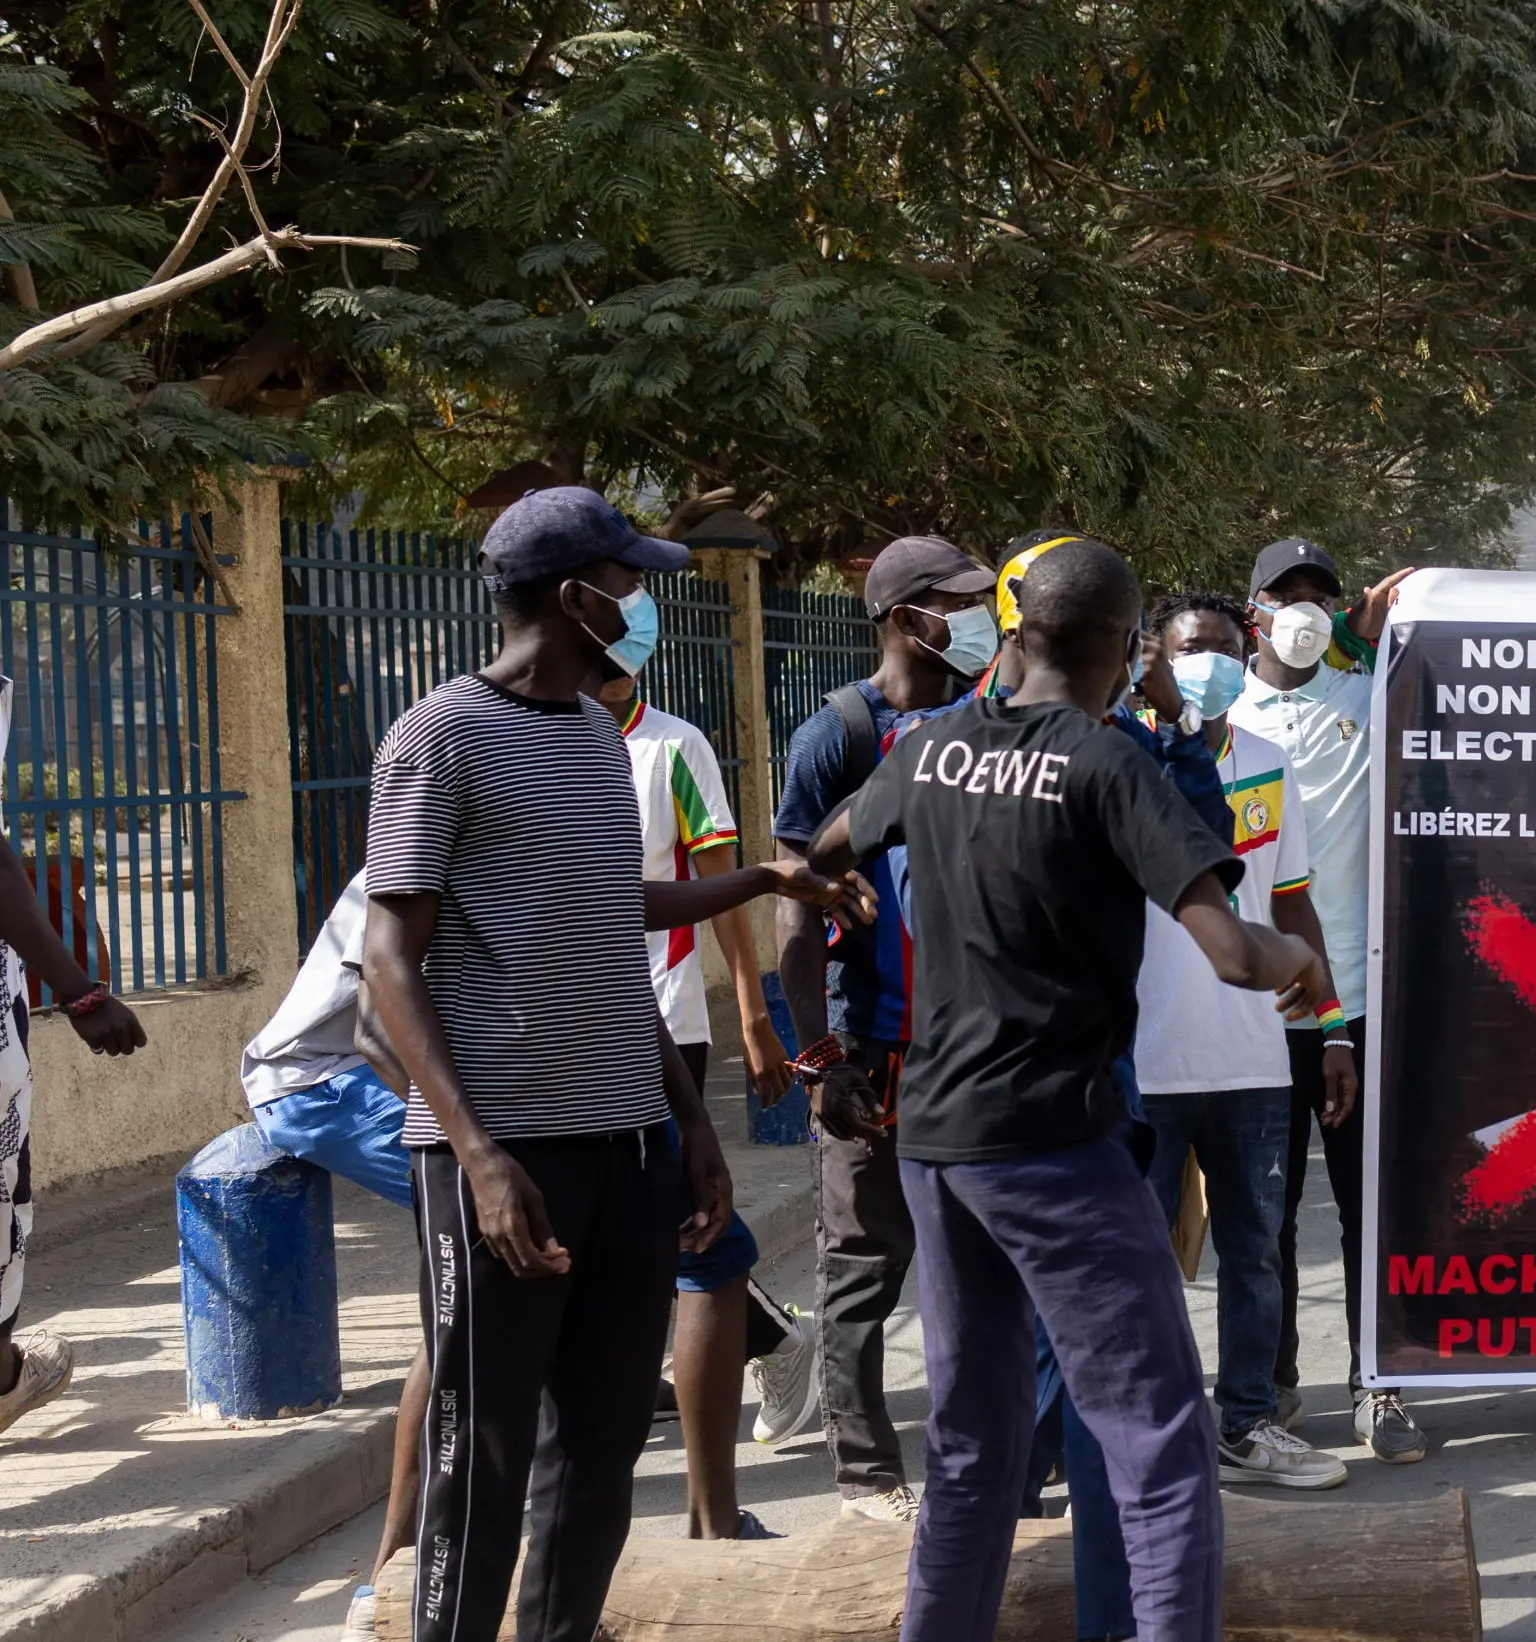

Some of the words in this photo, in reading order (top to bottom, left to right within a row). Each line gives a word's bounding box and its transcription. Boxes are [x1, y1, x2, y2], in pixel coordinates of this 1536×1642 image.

[1436, 684, 1530, 715] NON
[912, 740, 1071, 804] LOEWE
[1393, 807, 1511, 837] LIBÉREZ
[439, 1233, 453, 1326] DISTINCTIVE
[439, 1389, 456, 1475] DISTINCTIVE
[426, 1536, 449, 1622] DISTINCTIVE
